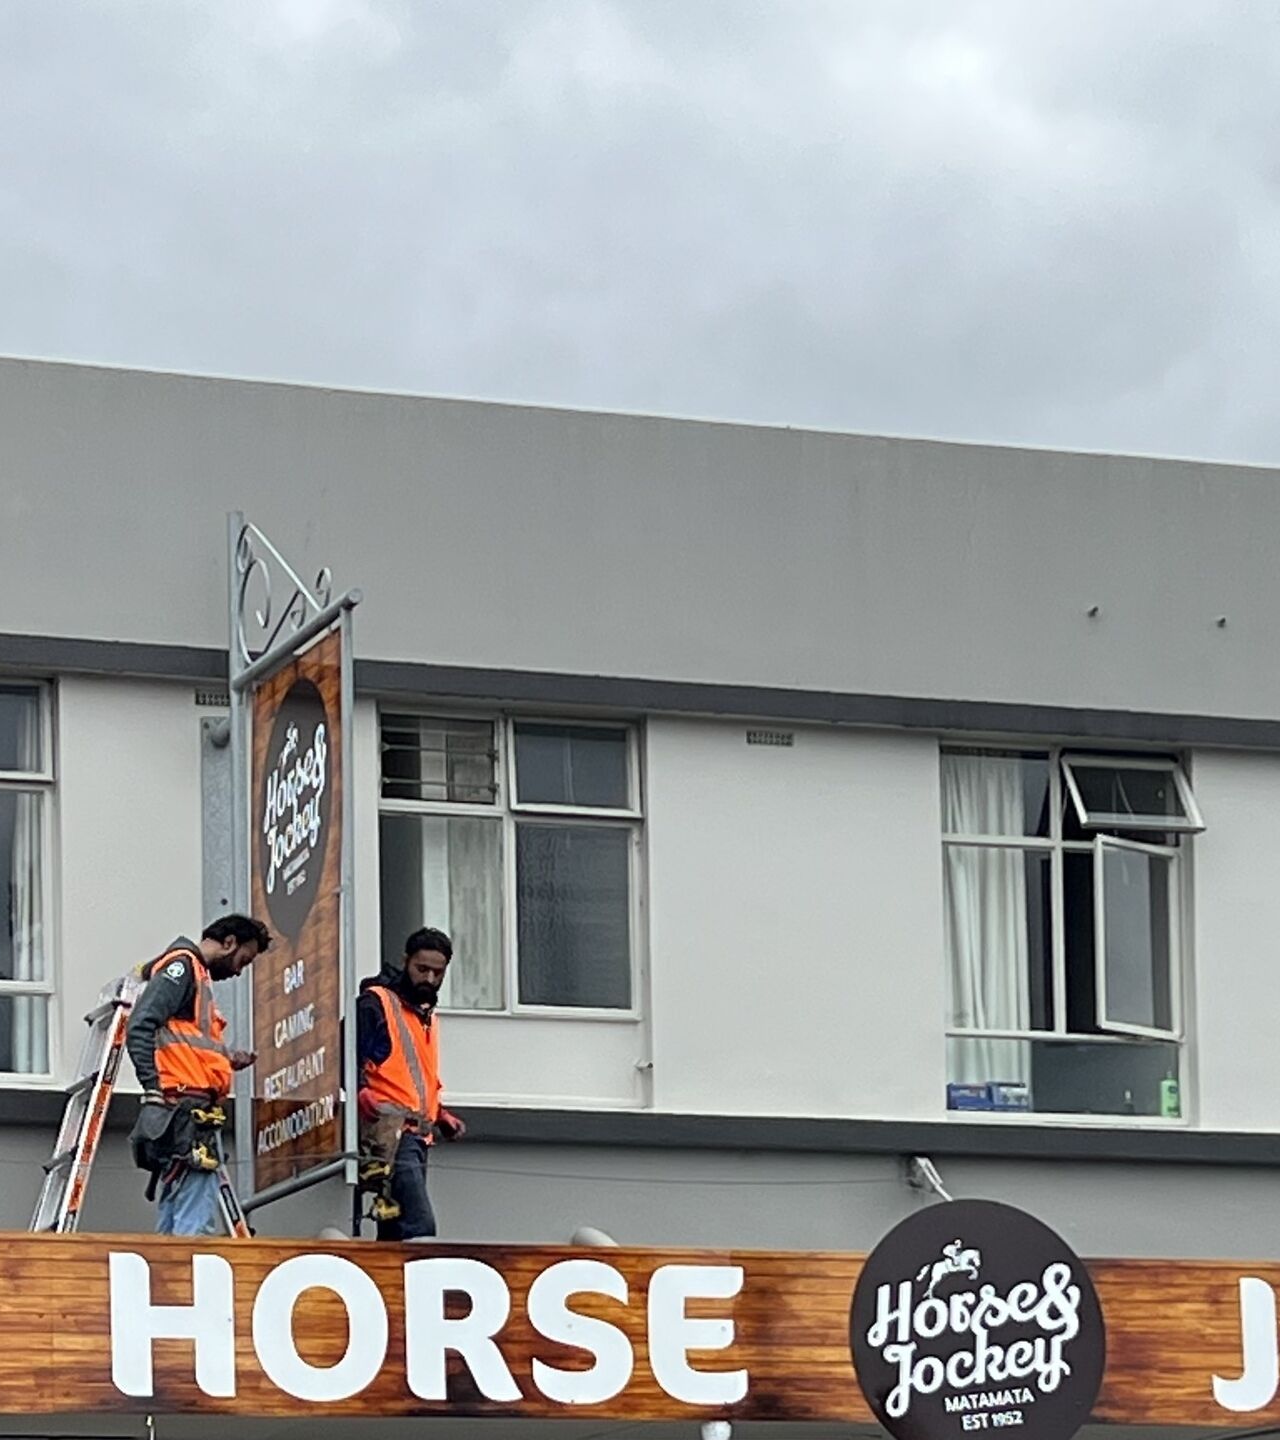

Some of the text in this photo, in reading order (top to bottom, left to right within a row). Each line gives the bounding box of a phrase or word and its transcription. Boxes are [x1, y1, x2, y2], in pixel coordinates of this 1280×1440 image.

[284, 960, 304, 994] BAR
[274, 1003, 315, 1048] GAMING
[264, 1046, 325, 1103] RESTAURANT
[109, 1251, 748, 1404] HORSE
[883, 1329, 1071, 1418] Jockey
[944, 1387, 1035, 1412] MATAMATA
[962, 1412, 988, 1431] EST
